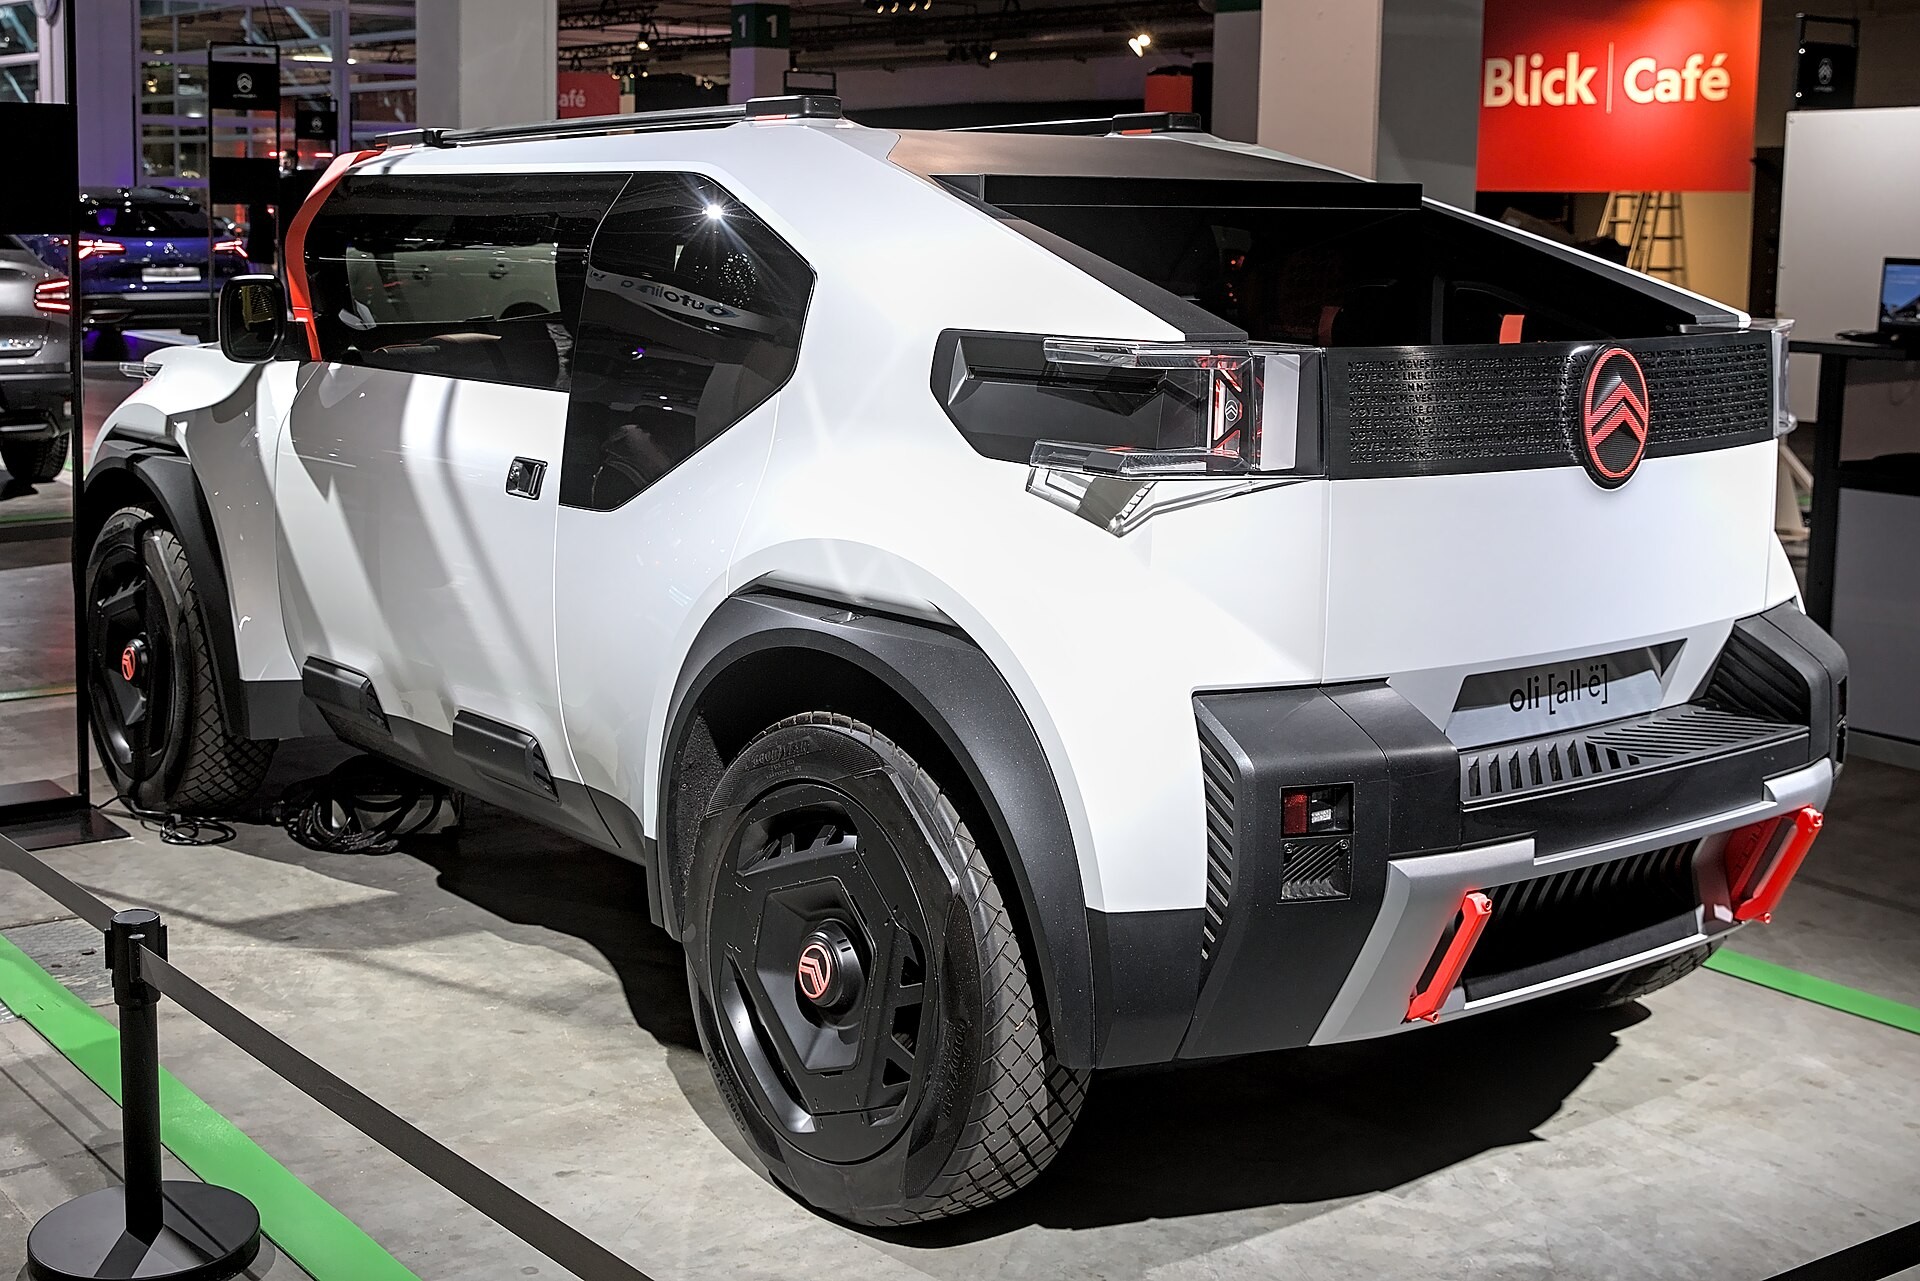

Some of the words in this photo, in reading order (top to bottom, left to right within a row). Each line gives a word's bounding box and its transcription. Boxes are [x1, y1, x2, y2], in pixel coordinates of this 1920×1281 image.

[738, 15, 747, 38] 1
[766, 15, 778, 38] 1
[1483, 51, 1598, 107] Blick
[1623, 53, 1731, 104] Café
[558, 89, 586, 108] afé
[1347, 360, 1394, 371] NOTHING
[1397, 359, 1430, 370] MOVES
[1448, 358, 1466, 369] LIKE
[1469, 357, 1506, 368] CITROEN
[1510, 676, 1539, 712] oli
[1548, 664, 1607, 715] [all-ë]
